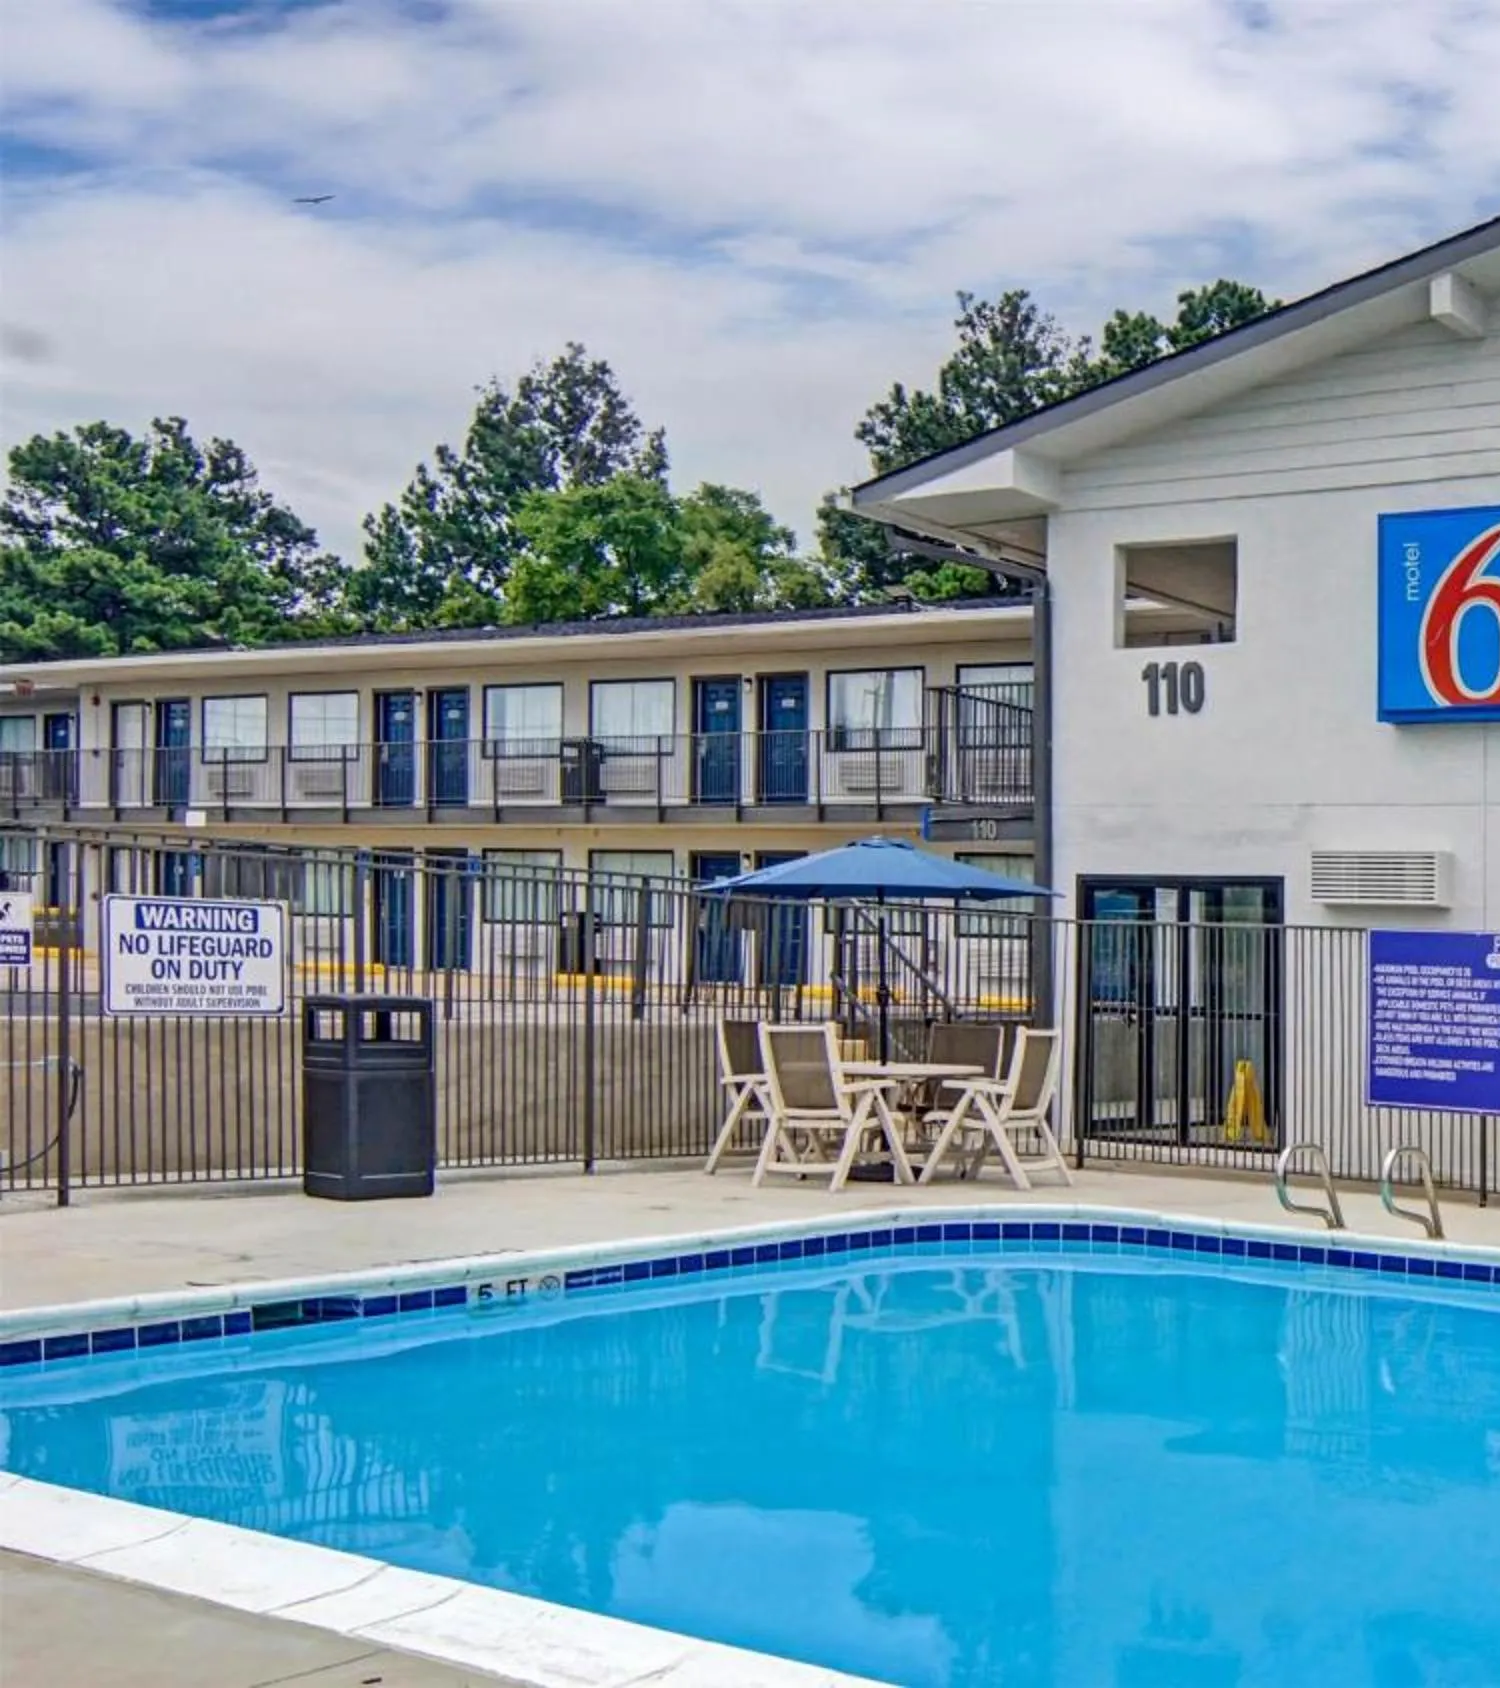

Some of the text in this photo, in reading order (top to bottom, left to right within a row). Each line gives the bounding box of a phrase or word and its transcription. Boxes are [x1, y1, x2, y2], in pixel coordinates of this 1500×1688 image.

[1404, 541, 1420, 602] motel
[1141, 660, 1206, 718] 110
[971, 819, 997, 840] 110
[141, 904, 255, 932] WARNING
[118, 933, 273, 959] NO LIFEGUARD
[150, 958, 244, 981] ON DUTY
[124, 983, 268, 997] CHILDREN SHOULD NOT USE POOL
[134, 996, 261, 1009] WITHOUT ADULT SUPERVISION
[477, 1278, 529, 1301] 5 FT
